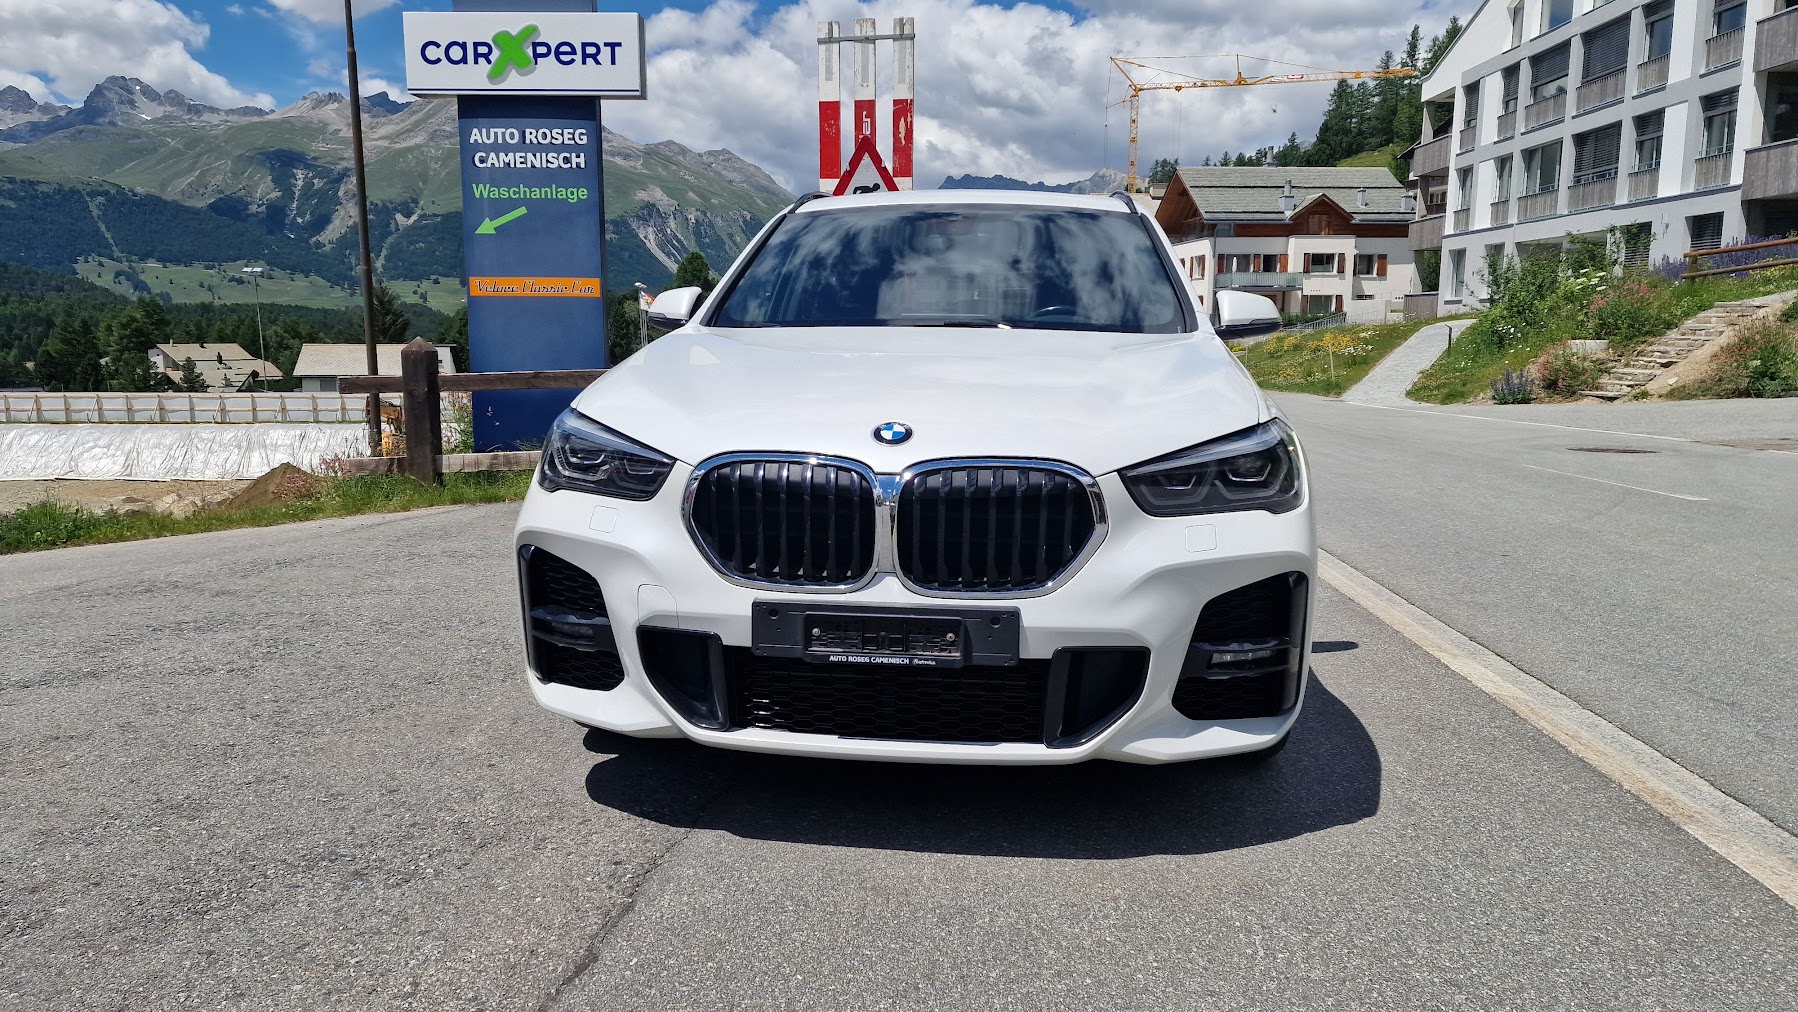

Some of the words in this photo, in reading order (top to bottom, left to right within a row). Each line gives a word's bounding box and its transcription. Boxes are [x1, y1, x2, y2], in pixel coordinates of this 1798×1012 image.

[469, 128, 519, 144] AUTO
[524, 128, 588, 145] ROSEG
[473, 152, 586, 169] CAMENISCH
[472, 183, 588, 202] Waschanlage
[522, 280, 569, 294] Classic
[871, 657, 910, 665] CAMENISCH
